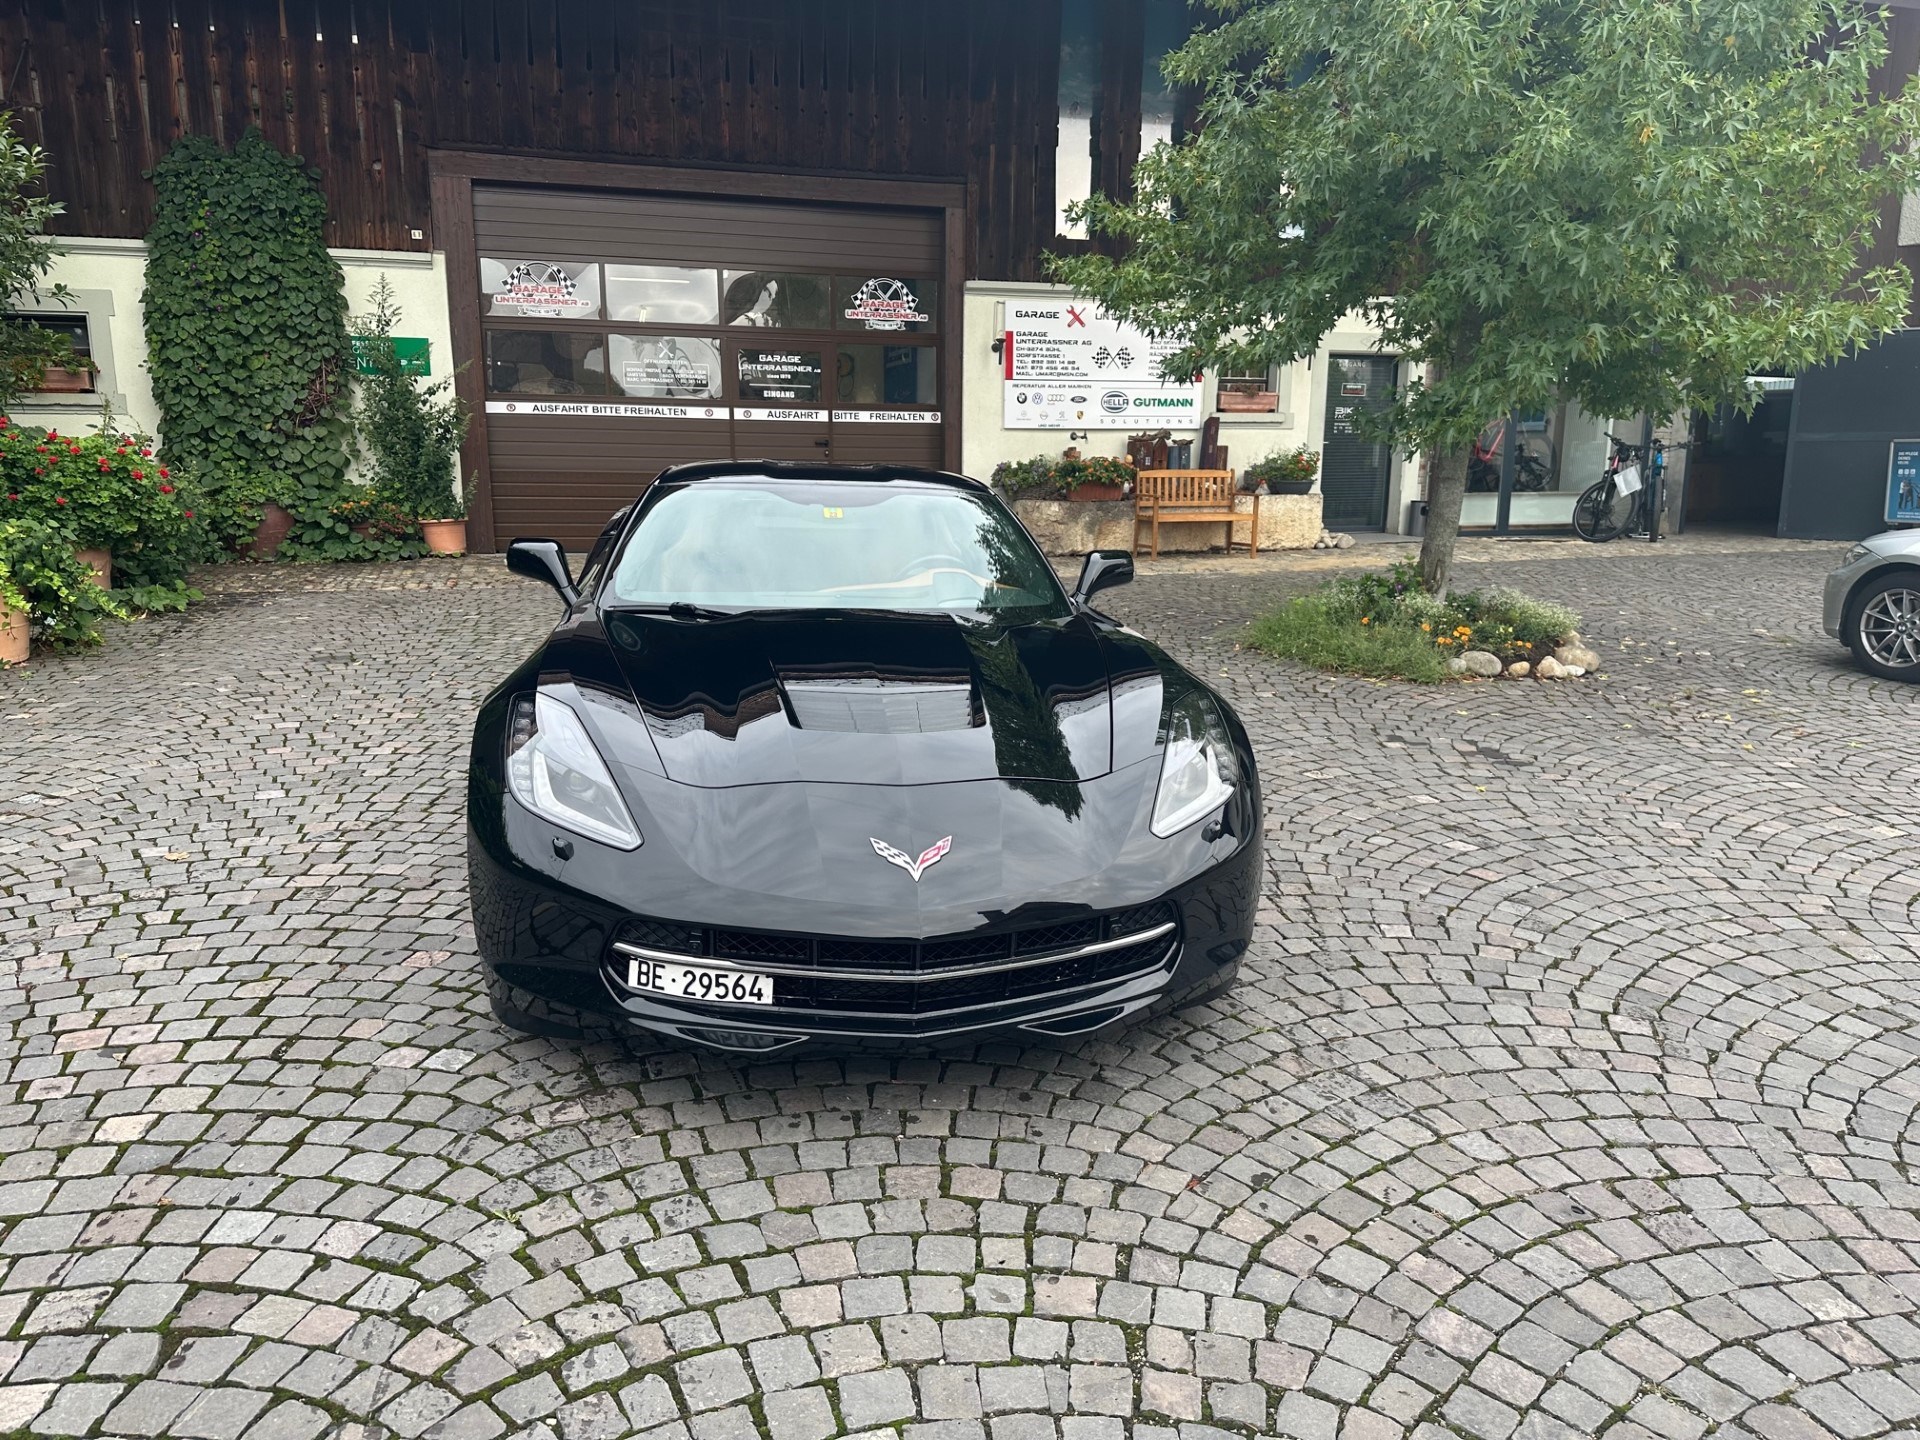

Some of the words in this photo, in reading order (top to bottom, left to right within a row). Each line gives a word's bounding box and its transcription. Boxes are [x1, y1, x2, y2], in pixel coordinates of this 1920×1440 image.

[512, 284, 566, 295] GARAGE
[494, 295, 578, 306] UNTERRASSNER
[862, 300, 908, 310] GARAGE
[846, 310, 918, 321] UNTERRASSNER
[1015, 310, 1060, 320] GARAGE
[758, 354, 802, 363] GARAGE
[763, 390, 795, 398] EINGANG
[1133, 398, 1194, 408] GUTMANN
[532, 404, 589, 413] AUSFAHRT
[592, 406, 621, 414] BITTE
[624, 407, 687, 416] FREIHALTEN
[767, 411, 820, 420] AUSFAHRT
[833, 412, 860, 420] BITTE
[869, 413, 925, 421] FREIHALTEN
